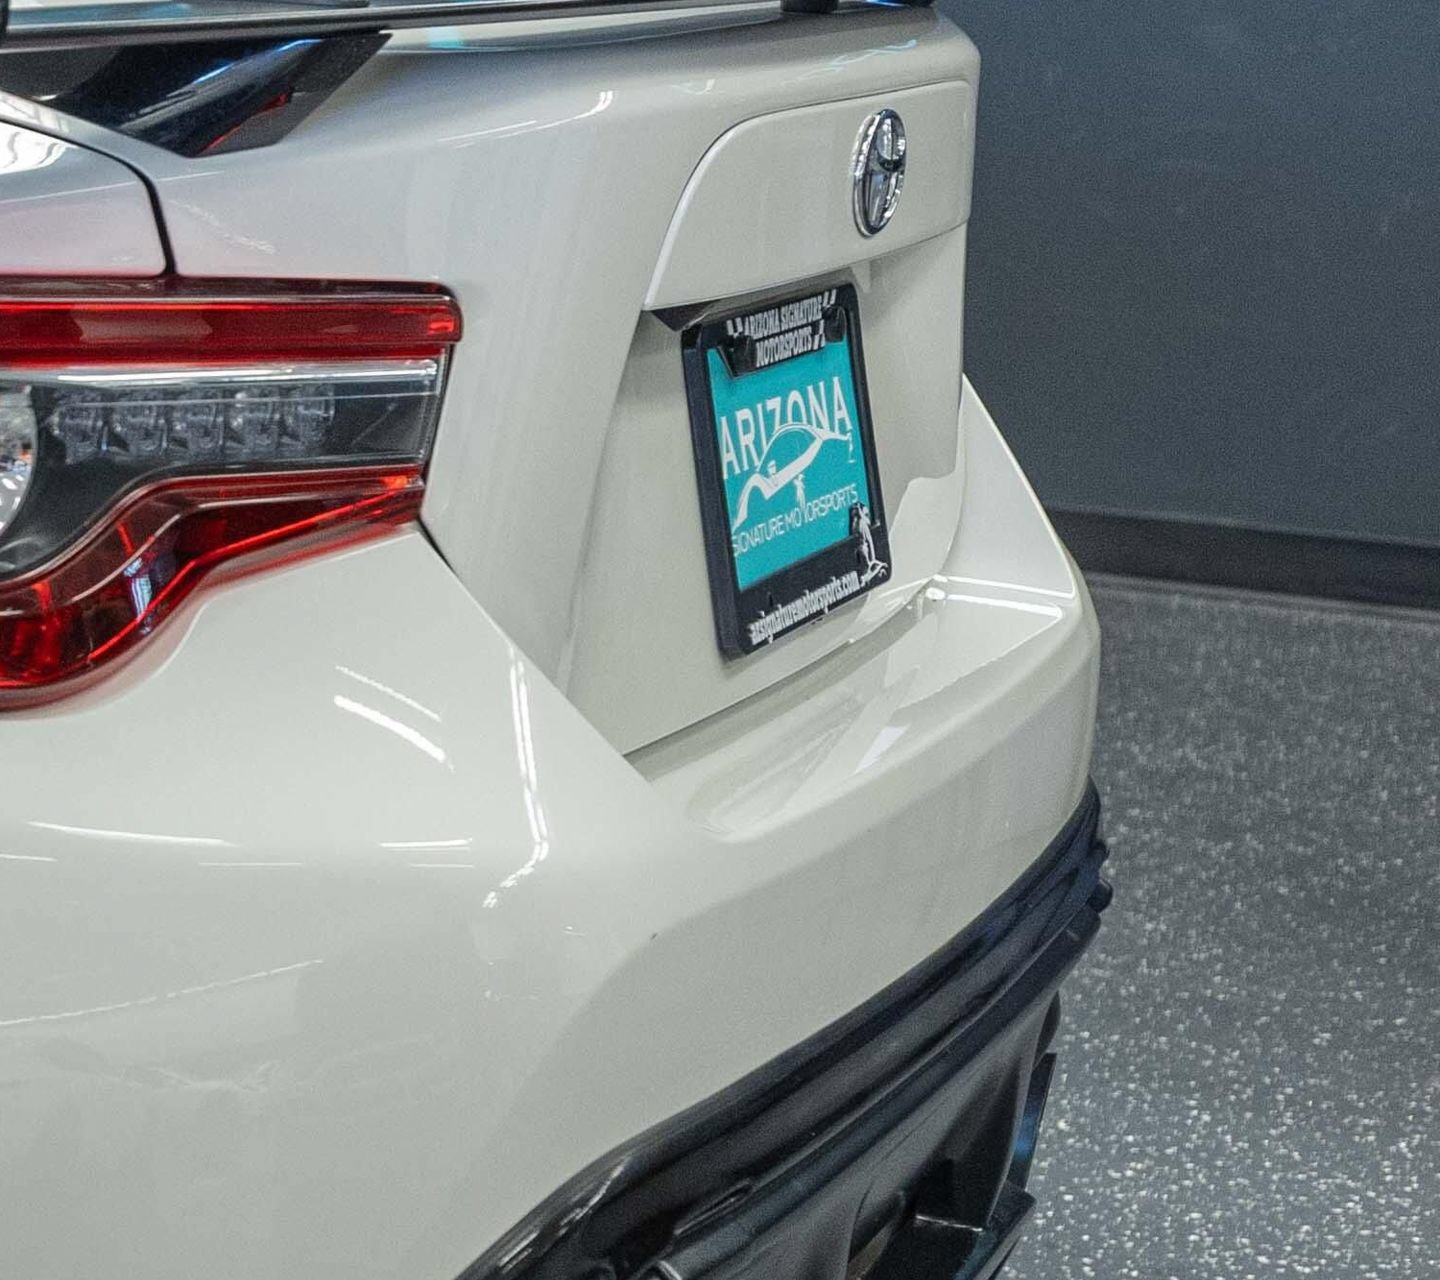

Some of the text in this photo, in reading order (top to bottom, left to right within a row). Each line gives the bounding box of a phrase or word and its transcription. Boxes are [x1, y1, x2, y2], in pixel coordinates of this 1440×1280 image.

[743, 296, 824, 337] ARIZONA SIGNATURE
[756, 327, 813, 369] MOTORSPORTS
[720, 375, 852, 480] ARIZONA
[733, 517, 784, 558] SIGNATURE
